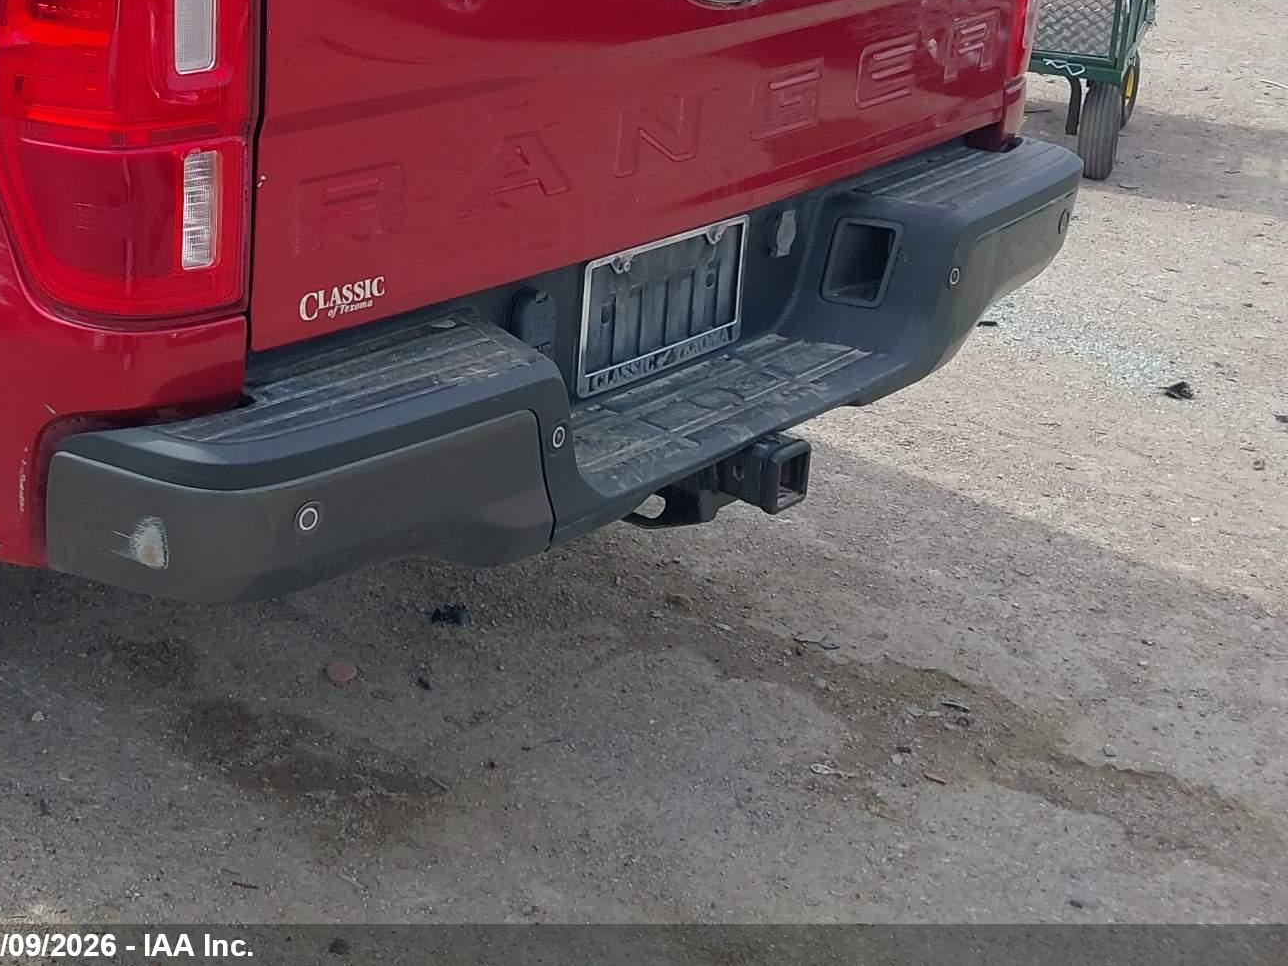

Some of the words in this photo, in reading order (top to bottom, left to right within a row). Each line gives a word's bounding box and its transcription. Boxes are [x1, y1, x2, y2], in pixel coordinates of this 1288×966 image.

[294, 6, 1001, 255] RANGER
[298, 276, 385, 321] CLASSIC
[327, 306, 338, 319] of
[339, 299, 373, 315] Texoma
